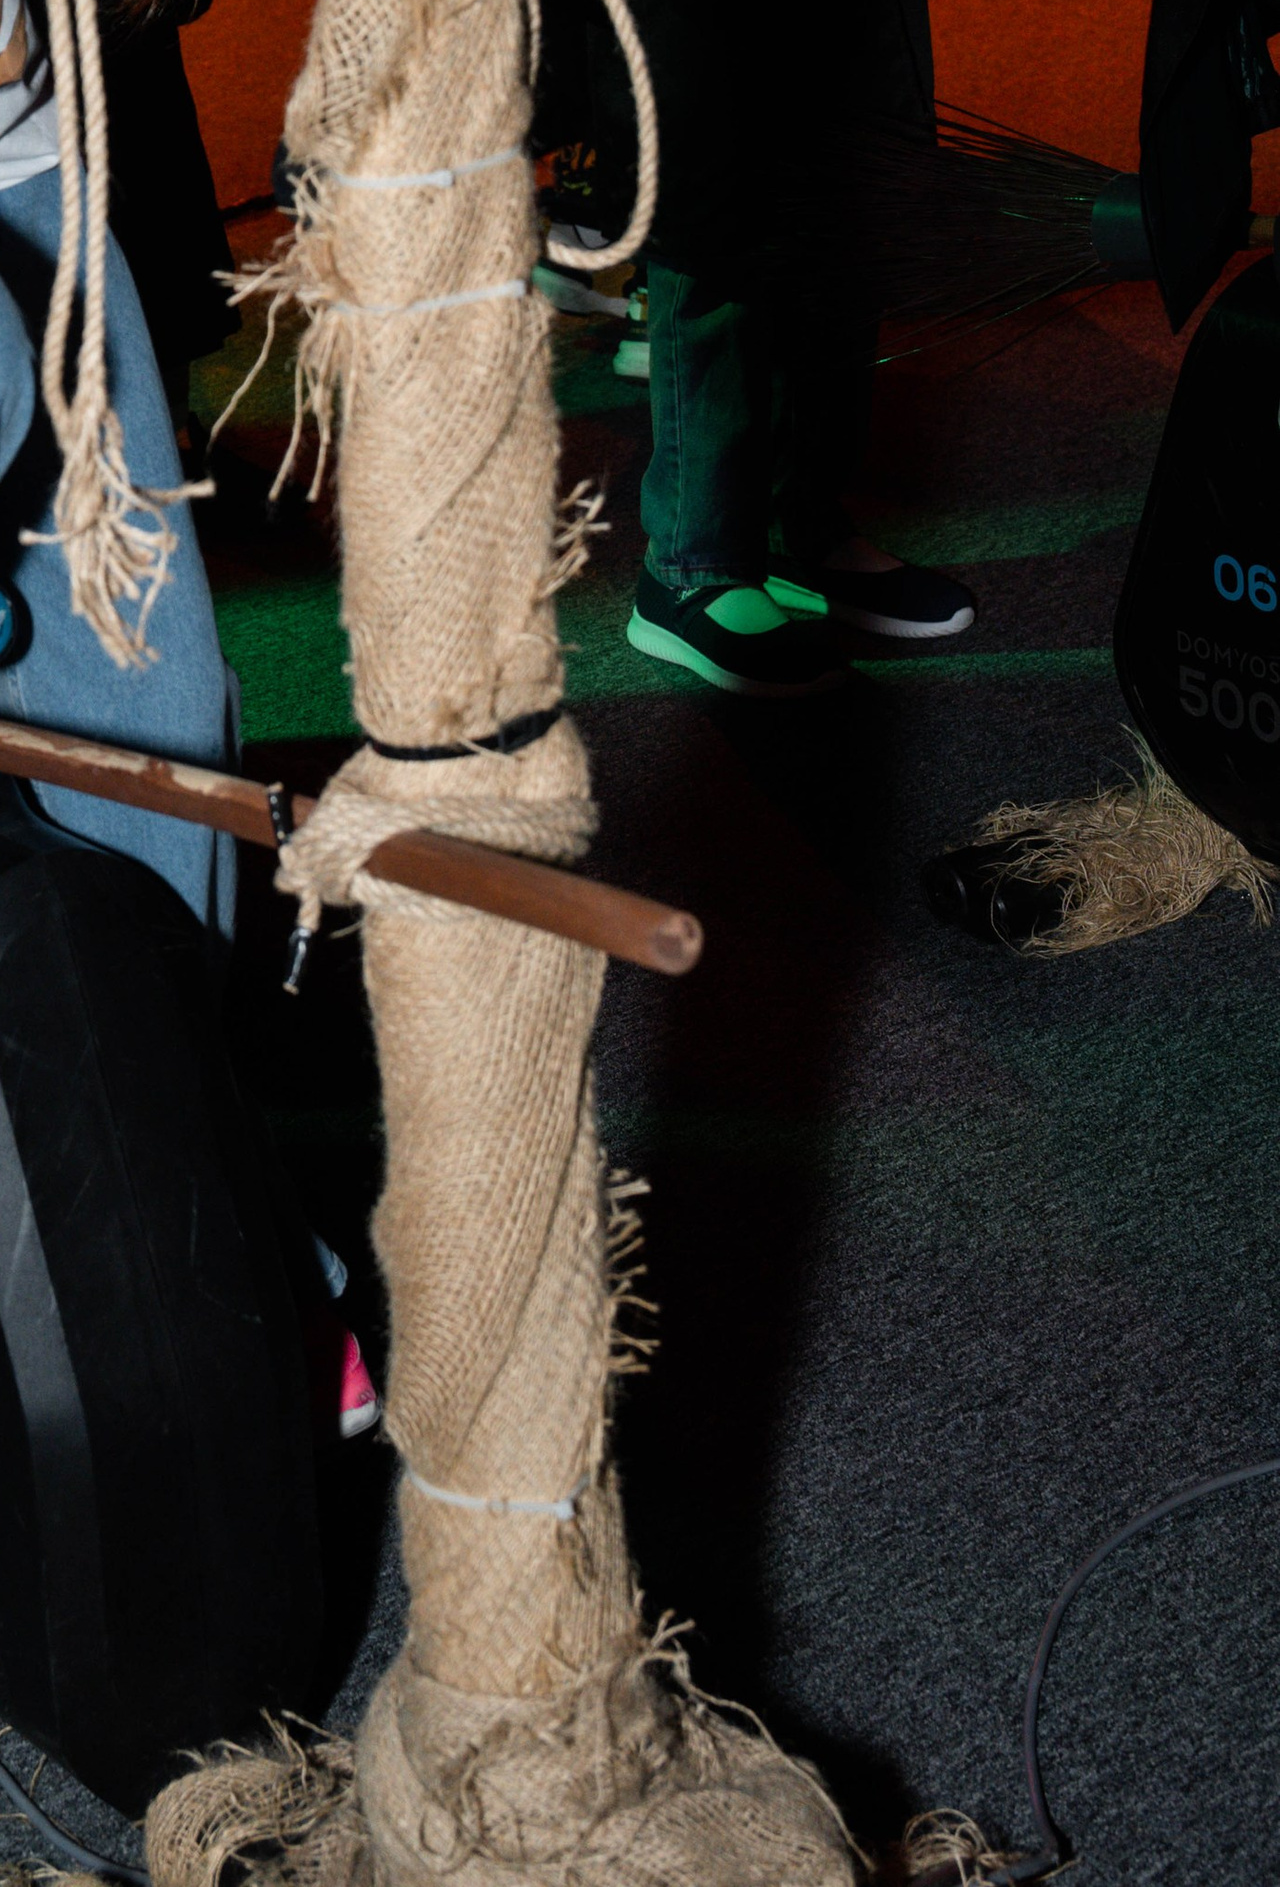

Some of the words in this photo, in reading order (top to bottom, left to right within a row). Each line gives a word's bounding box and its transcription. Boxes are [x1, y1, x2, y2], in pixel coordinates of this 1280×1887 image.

[1213, 554, 1278, 612] 06
[1176, 630, 1280, 684] DOMYOS
[1178, 664, 1280, 744] 500
